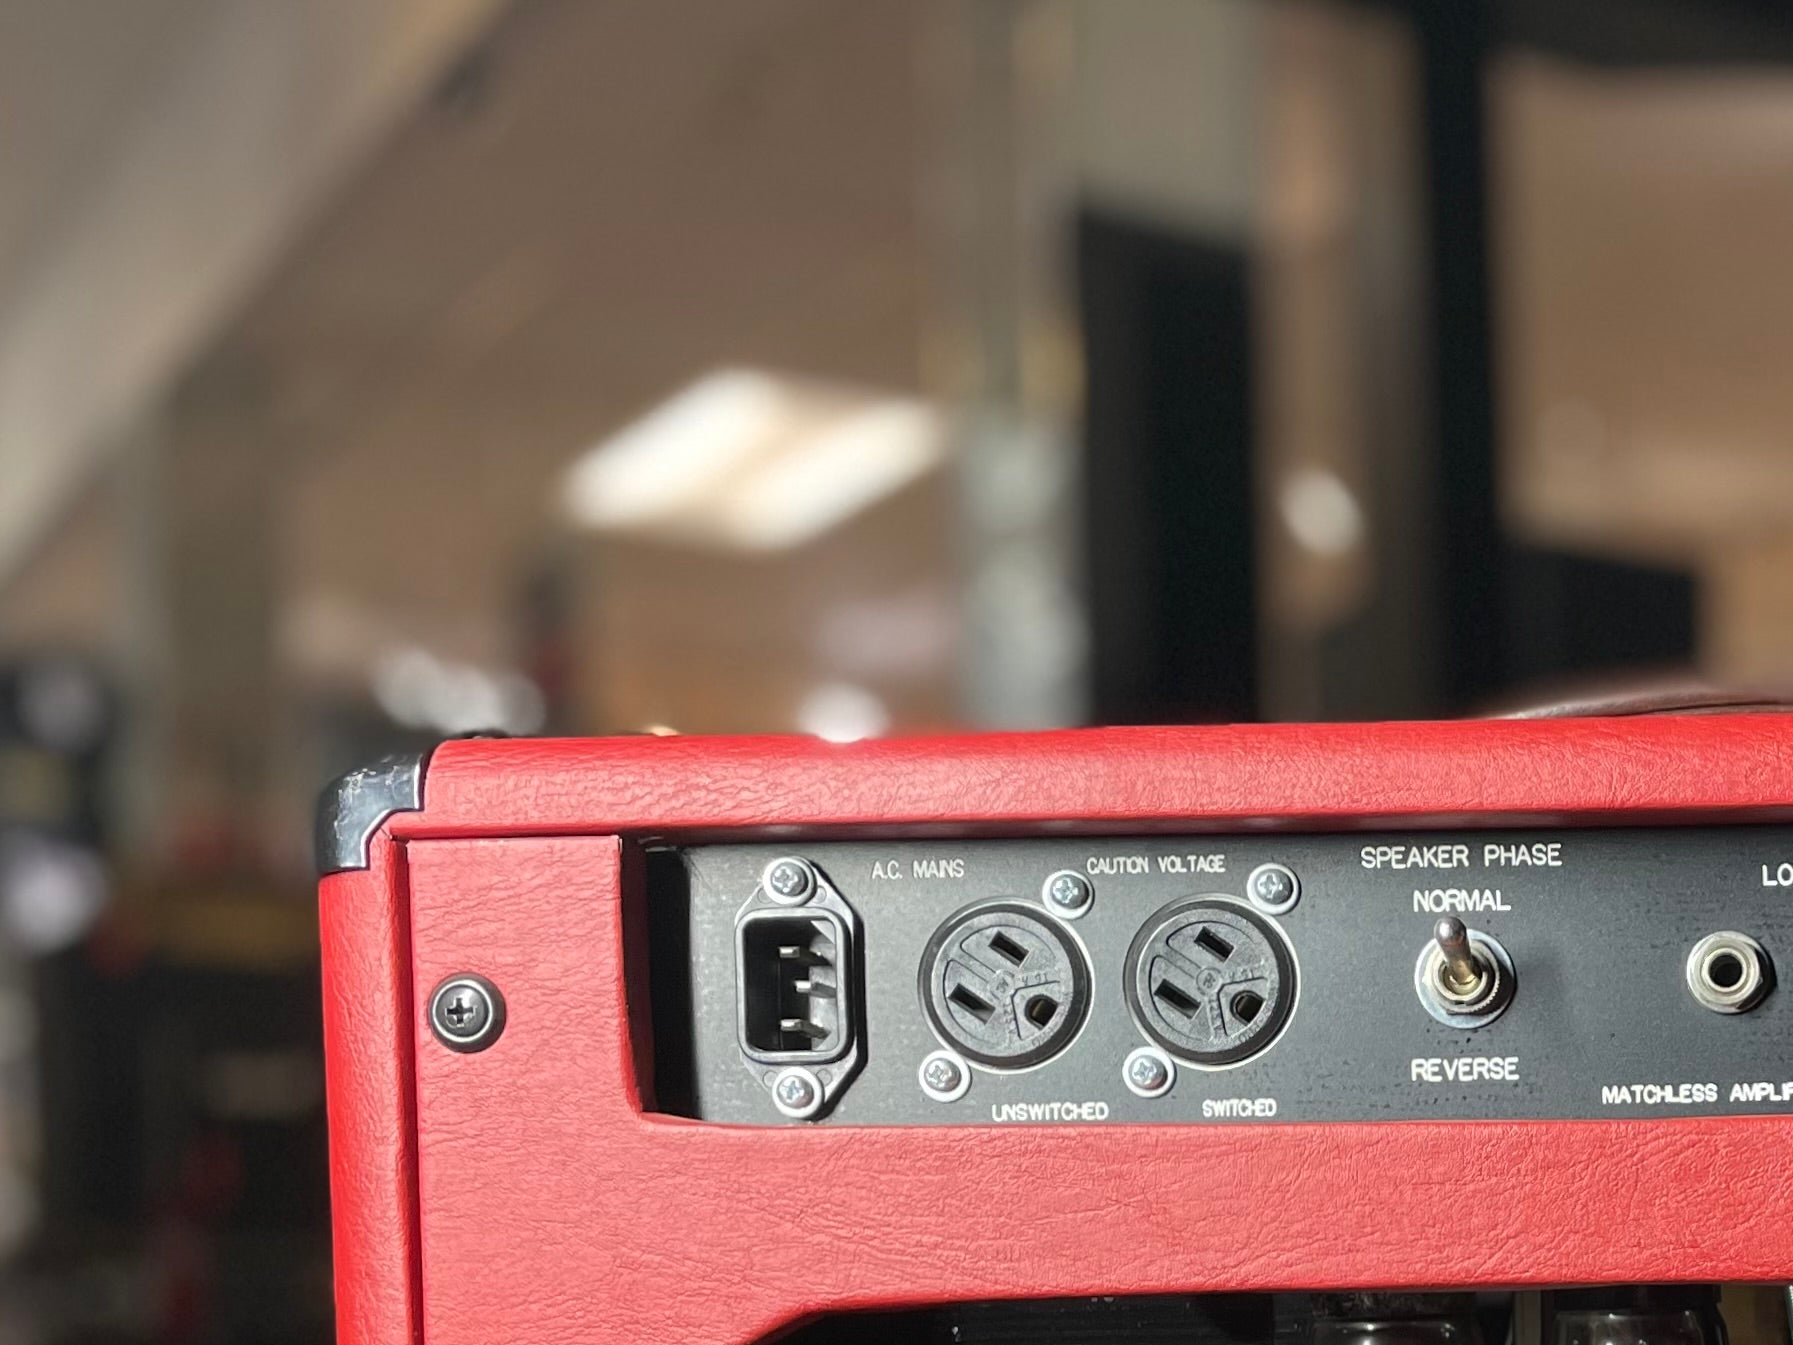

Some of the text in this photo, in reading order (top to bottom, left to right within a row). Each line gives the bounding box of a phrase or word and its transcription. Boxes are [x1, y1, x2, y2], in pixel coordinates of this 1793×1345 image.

[1086, 854, 1226, 875] CAUTION VOLTAGE
[1360, 843, 1563, 870] SPEAKER PHASE
[871, 858, 965, 881] A.C. MAINS
[1413, 888, 1512, 913] NORMAL
[1410, 1056, 1520, 1083] REVERSE
[1601, 1082, 1718, 1105] MATCHLESS
[991, 1101, 1110, 1123] UNSWITCHED
[1201, 1097, 1277, 1118] SWITCHED
